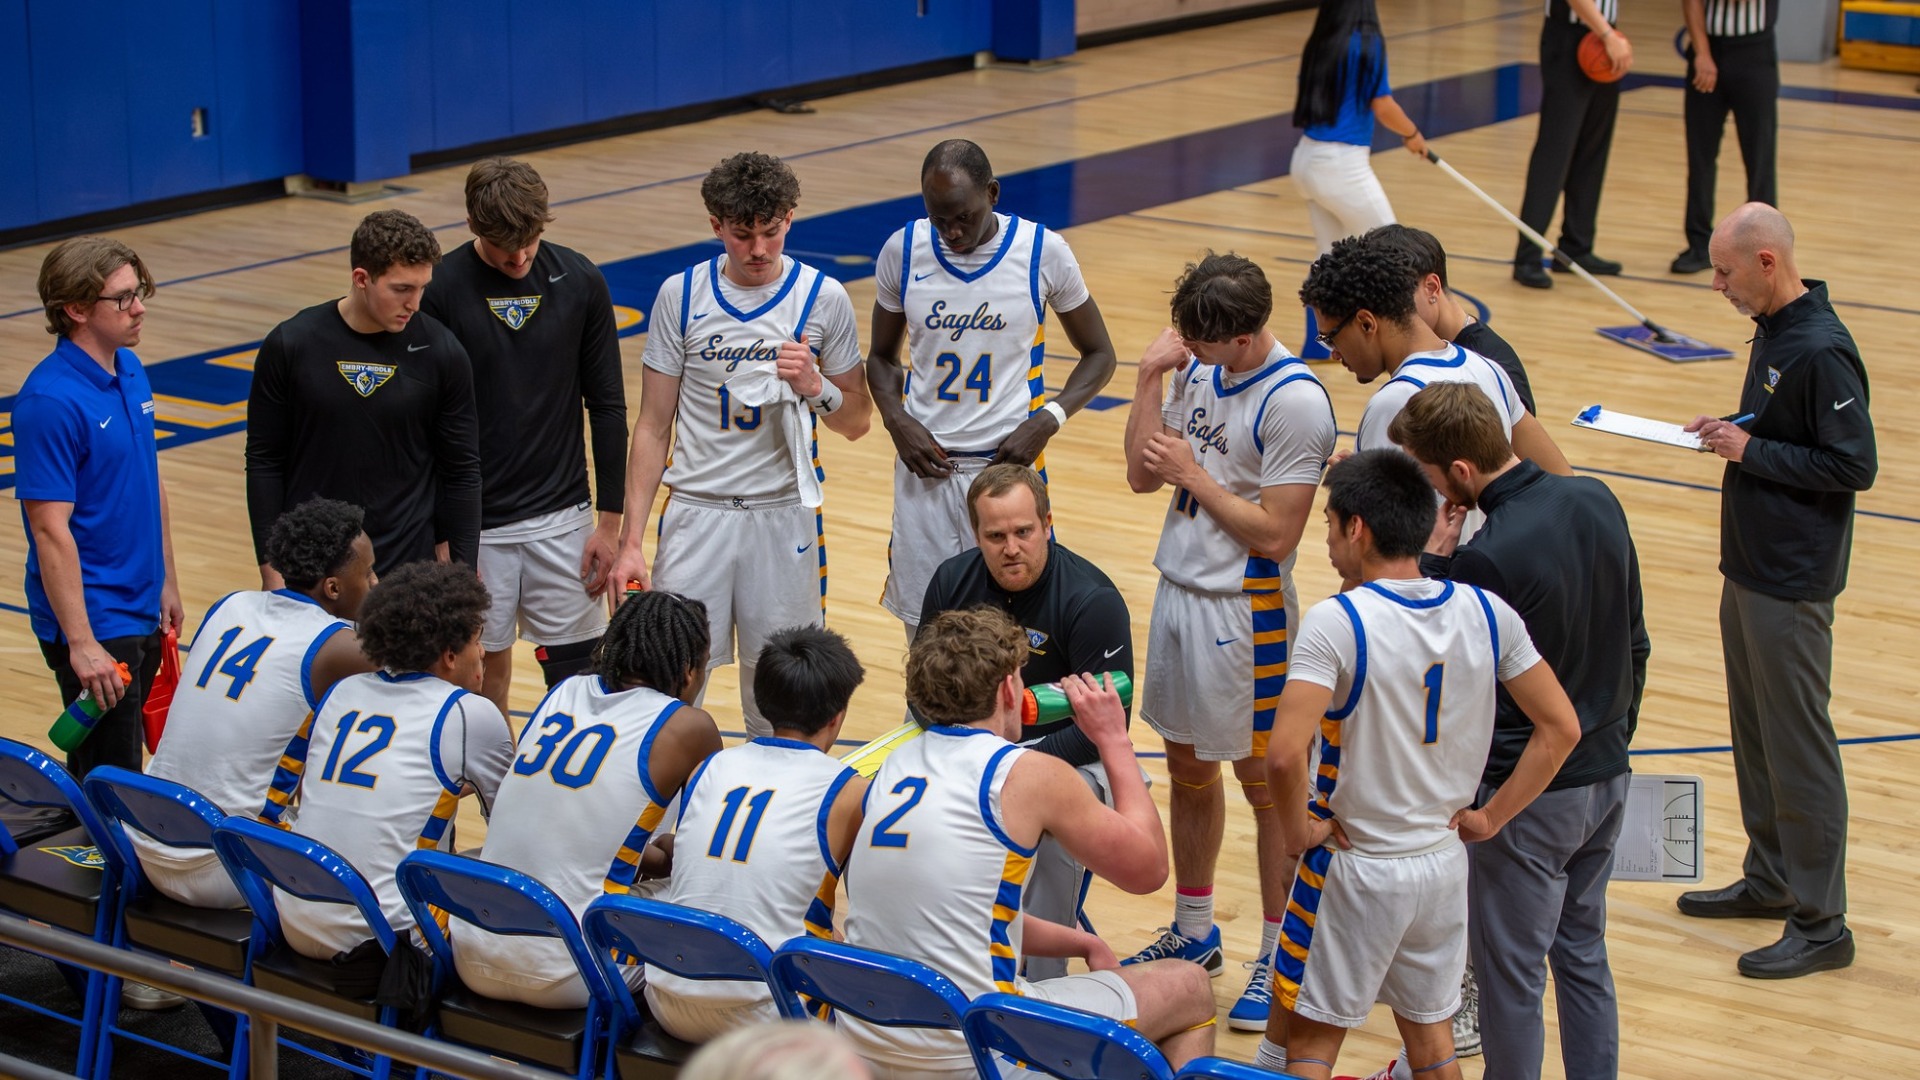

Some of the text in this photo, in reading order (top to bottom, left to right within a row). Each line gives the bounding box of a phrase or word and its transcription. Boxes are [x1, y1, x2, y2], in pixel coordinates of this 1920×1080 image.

[700, 334, 779, 373] Eagles
[924, 300, 1007, 342] Eagles
[341, 363, 393, 373] EMBRY-RIDDLE
[936, 352, 993, 404] 24
[195, 625, 276, 703] 14
[1421, 661, 1446, 746] 1
[320, 710, 399, 791] 12
[513, 710, 619, 792] 30
[706, 785, 778, 865] 11
[869, 775, 929, 850] 2
